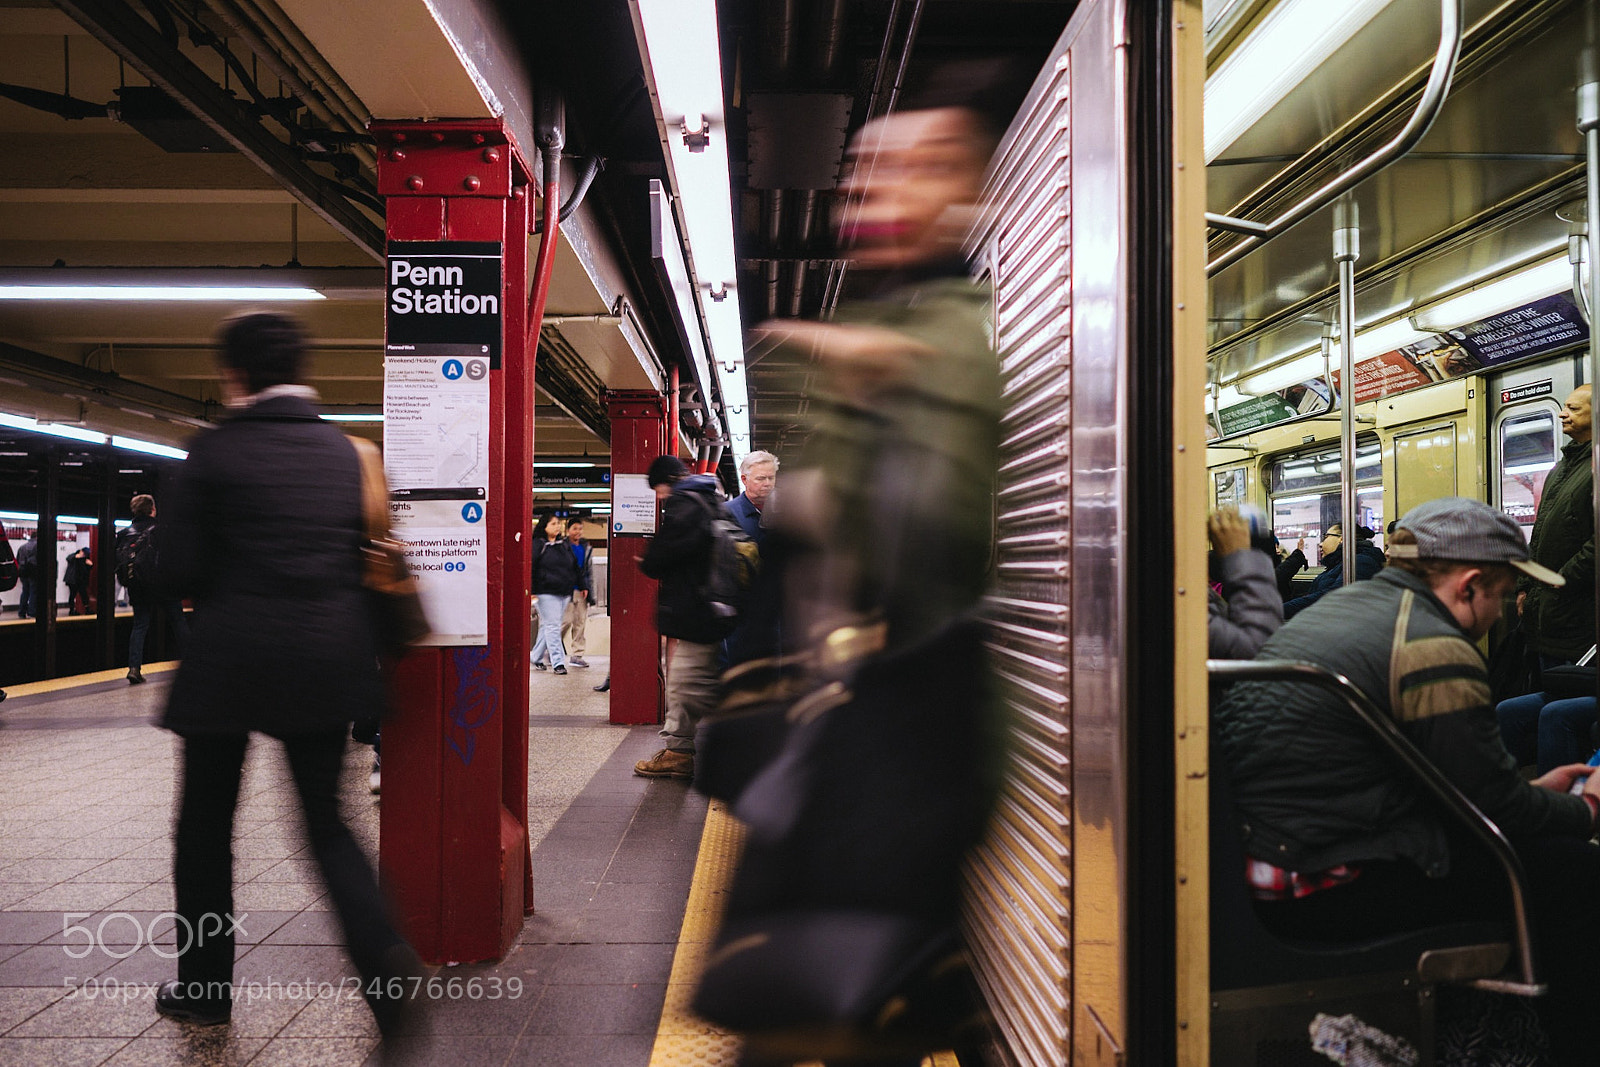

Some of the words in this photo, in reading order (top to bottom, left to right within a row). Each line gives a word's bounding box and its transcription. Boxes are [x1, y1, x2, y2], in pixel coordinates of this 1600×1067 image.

[391, 260, 463, 286] Penn
[391, 287, 498, 315] Station
[1488, 317, 1504, 330] TO
[1500, 312, 1522, 326] HELP
[1518, 307, 1541, 320] THE
[1471, 326, 1515, 346] HOMELESS
[1511, 320, 1533, 334] THIS
[1528, 312, 1566, 329] WINTER
[1525, 387, 1536, 395] hold
[1536, 385, 1551, 393] doors
[564, 476, 587, 484] Garden
[442, 538, 458, 546] late
[459, 538, 481, 548] night
[415, 549, 424, 557] at
[425, 549, 440, 557] this
[441, 548, 478, 558] platform
[422, 562, 443, 571] local
